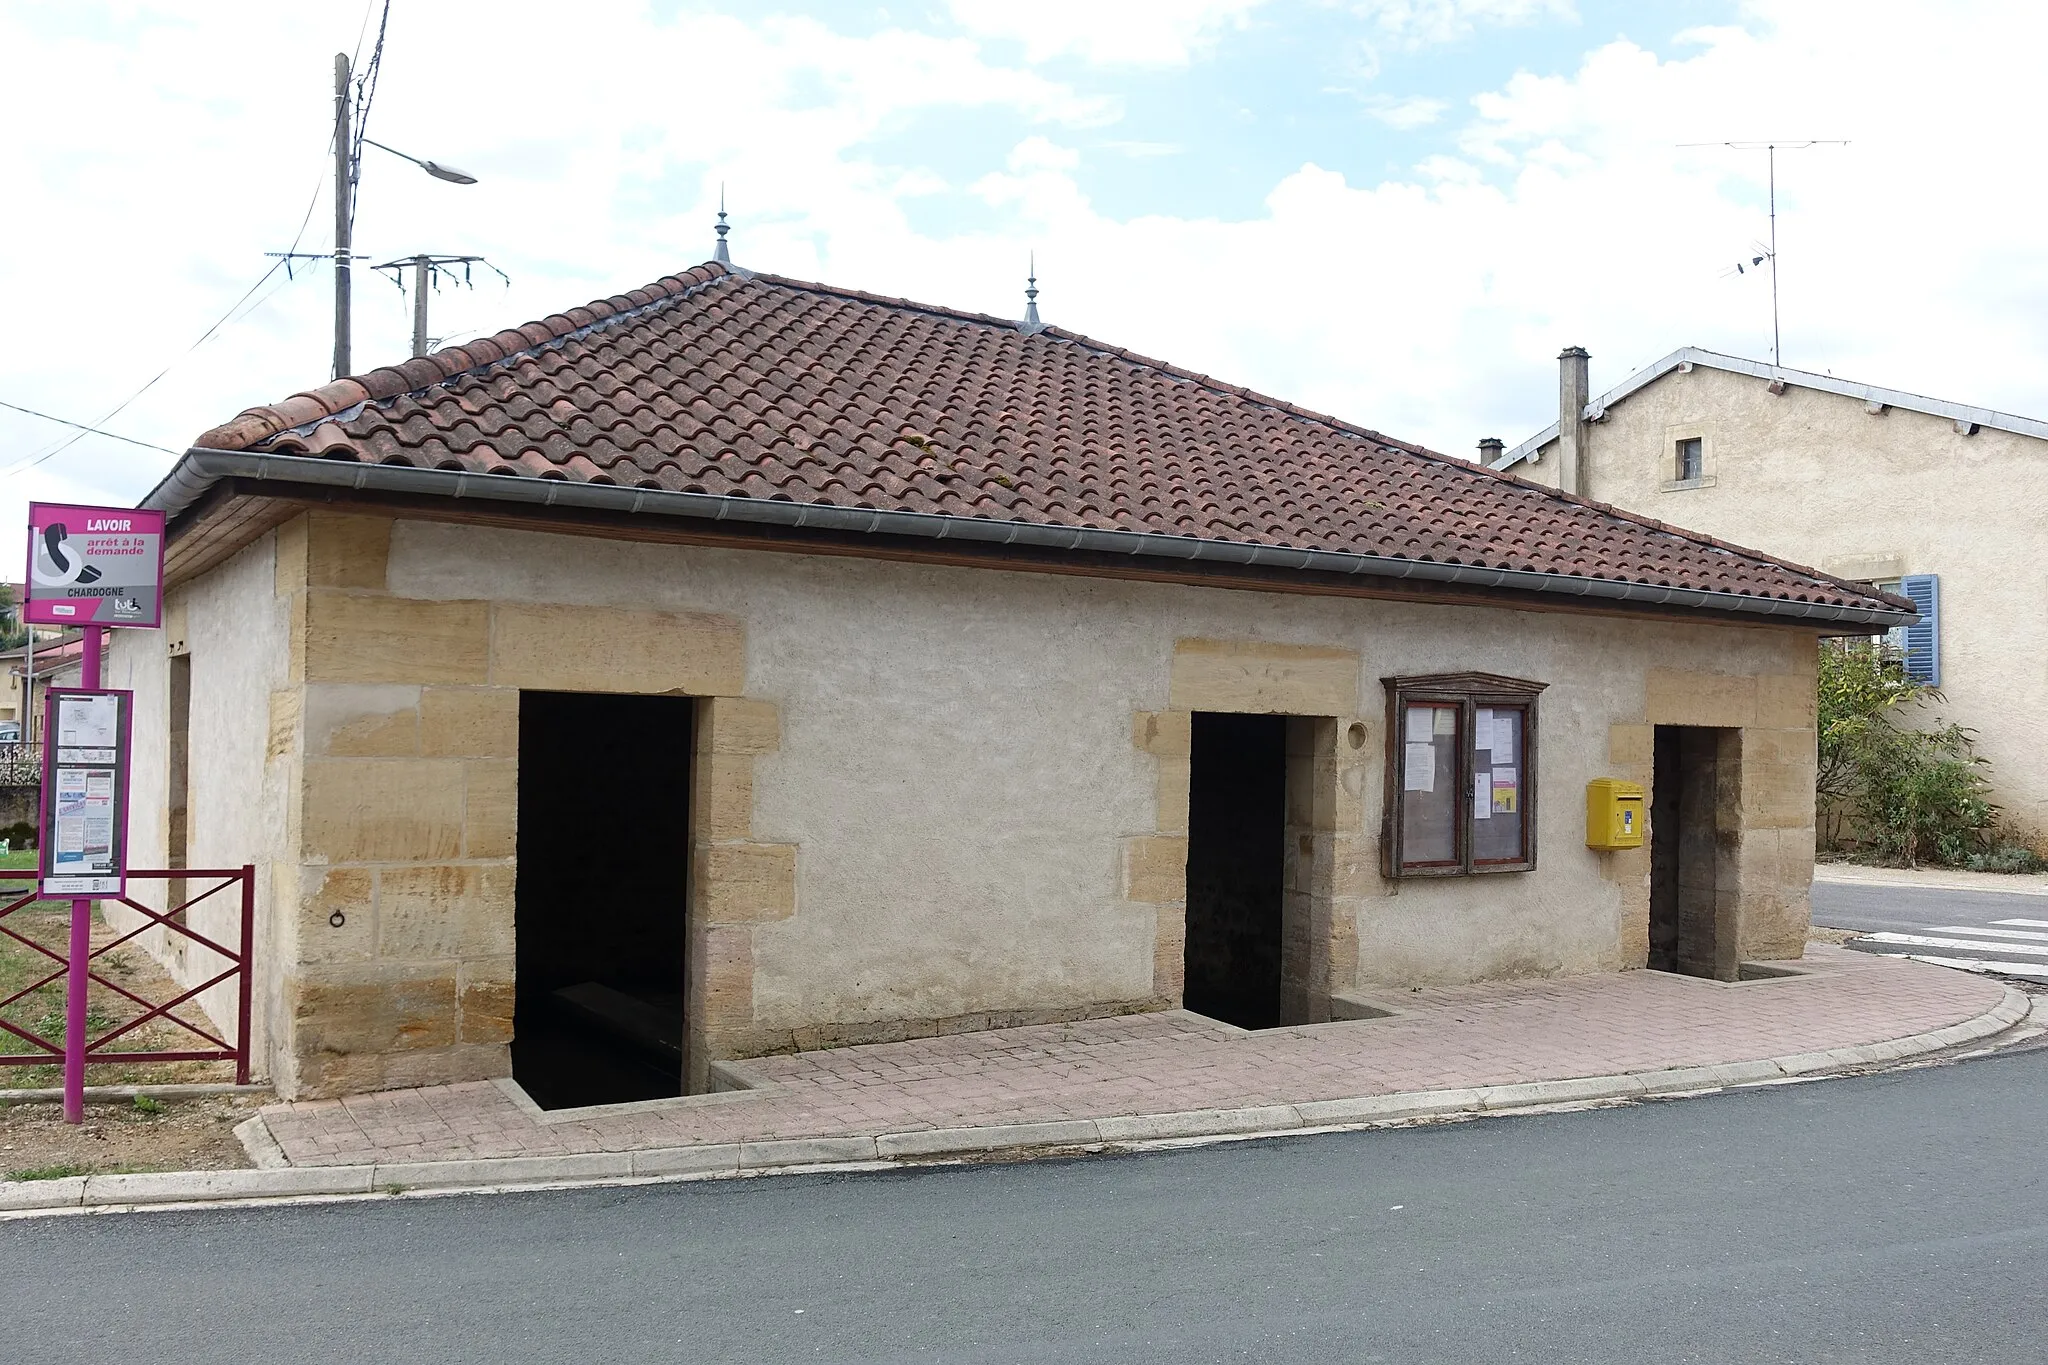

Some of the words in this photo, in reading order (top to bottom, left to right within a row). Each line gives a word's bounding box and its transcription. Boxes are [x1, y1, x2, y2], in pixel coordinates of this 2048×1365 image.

[86, 519, 132, 532] LAVOIR
[87, 538, 119, 547] arrêt
[122, 538, 130, 546] à
[133, 538, 145, 546] la
[86, 546, 144, 555] demande
[67, 587, 124, 597] CHARDOGNE
